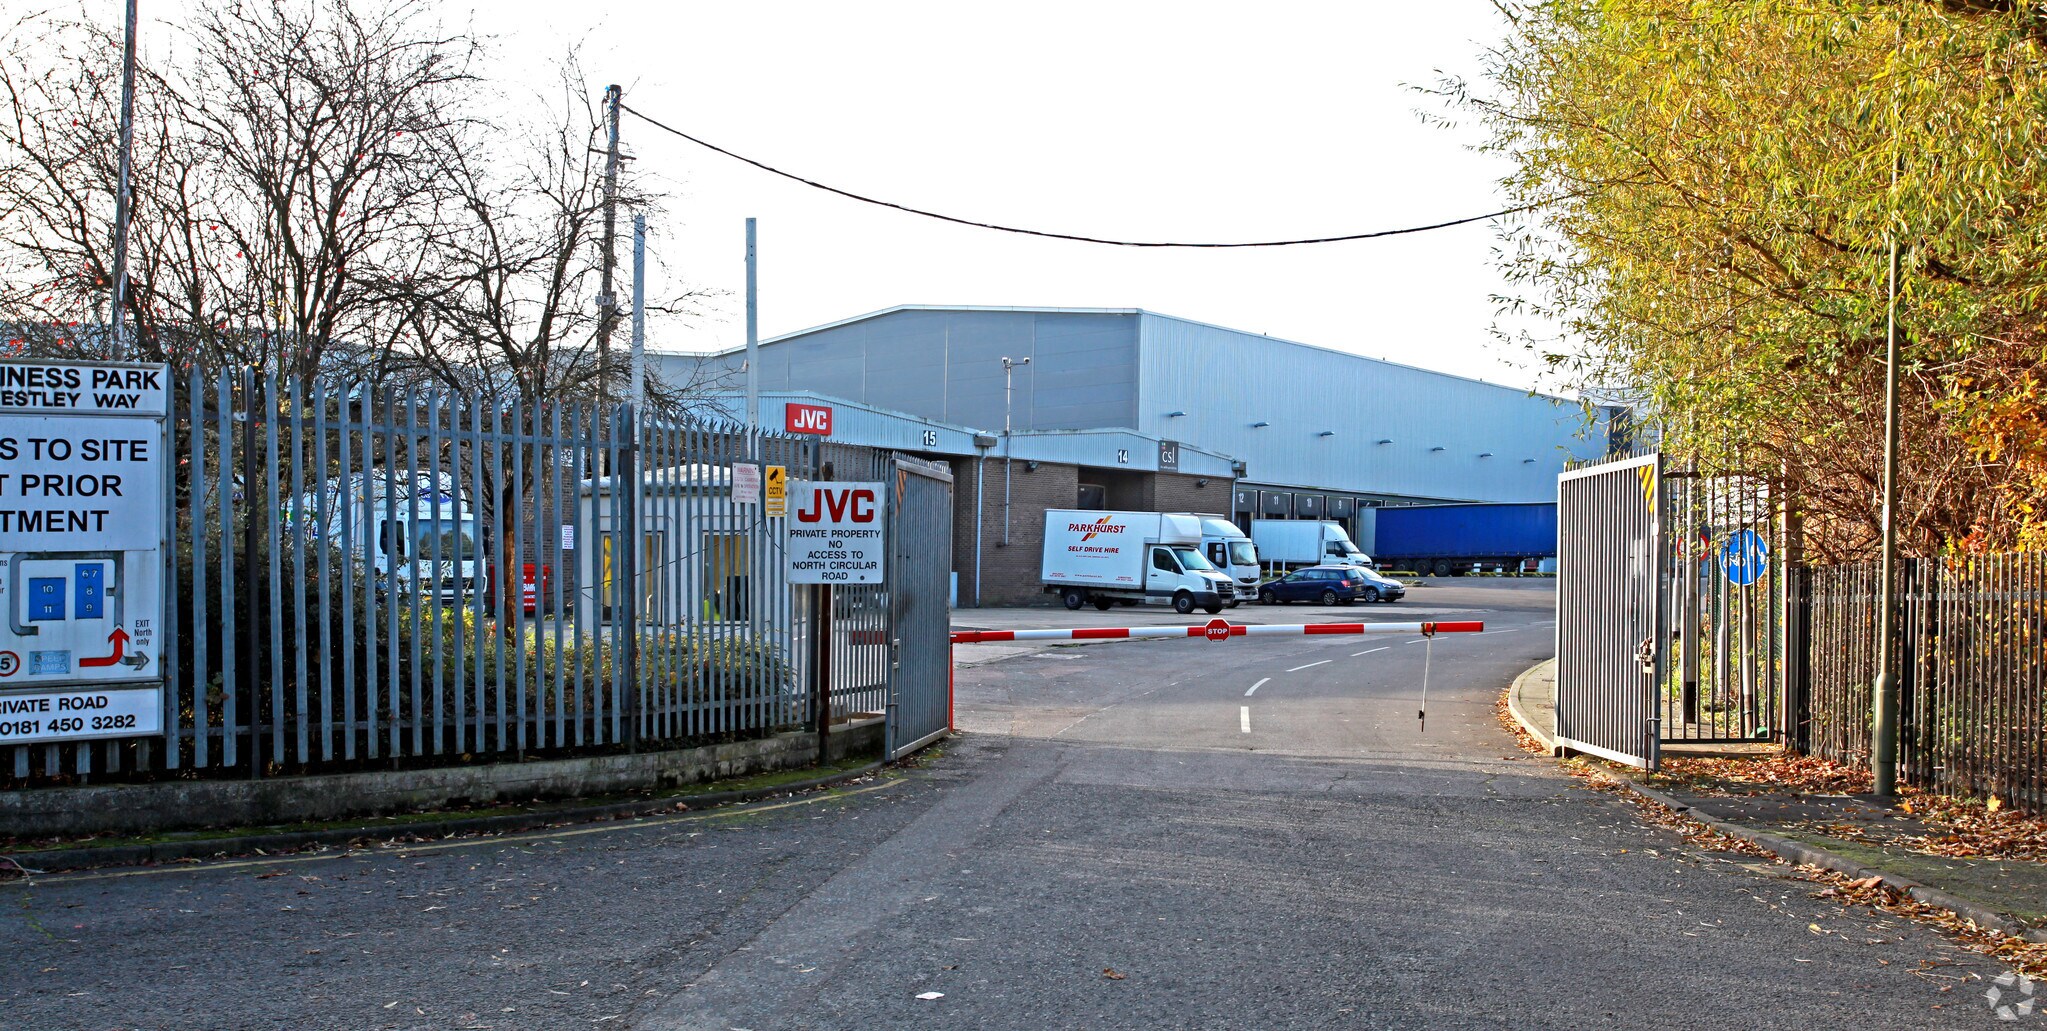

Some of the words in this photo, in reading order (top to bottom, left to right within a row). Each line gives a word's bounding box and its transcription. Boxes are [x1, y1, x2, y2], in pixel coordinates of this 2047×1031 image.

[0, 367, 81, 389] INESS
[92, 369, 161, 390] PARK
[2, 390, 81, 407] ESTLEY
[93, 393, 141, 408] WAY
[794, 408, 827, 430] JVC
[923, 430, 936, 446] 15
[28, 438, 72, 461] TO
[80, 438, 148, 462] SITE
[1162, 446, 1175, 463] csl
[1118, 450, 1128, 463] 14
[21, 474, 123, 497] PRIOR
[768, 486, 782, 495] CCTV
[1238, 492, 1245, 503] 12
[1274, 495, 1279, 505] 11
[797, 489, 875, 523] JVC
[0, 510, 109, 533] TMENT
[1068, 523, 1126, 534] PARKHURST
[790, 530, 827, 538] PRIVATE
[831, 530, 880, 538] PROPERTY
[828, 540, 843, 549] NO
[807, 551, 847, 559] ACCESS
[850, 551, 863, 559] TO
[792, 562, 826, 570] NORTH
[829, 562, 877, 570] CIRCULAR
[92, 570, 98, 578] 7
[821, 572, 848, 580] ROAD
[43, 585, 54, 593] 10
[86, 587, 93, 595] 8
[43, 605, 52, 613] 11
[86, 604, 93, 612] 9
[135, 620, 150, 628] EXIT
[134, 629, 152, 637] North
[136, 638, 150, 646] only
[0, 699, 50, 714] IVATE
[58, 696, 108, 710] ROAD
[0, 720, 40, 735] 0181
[47, 718, 84, 732] 450
[92, 714, 136, 730] 3282
